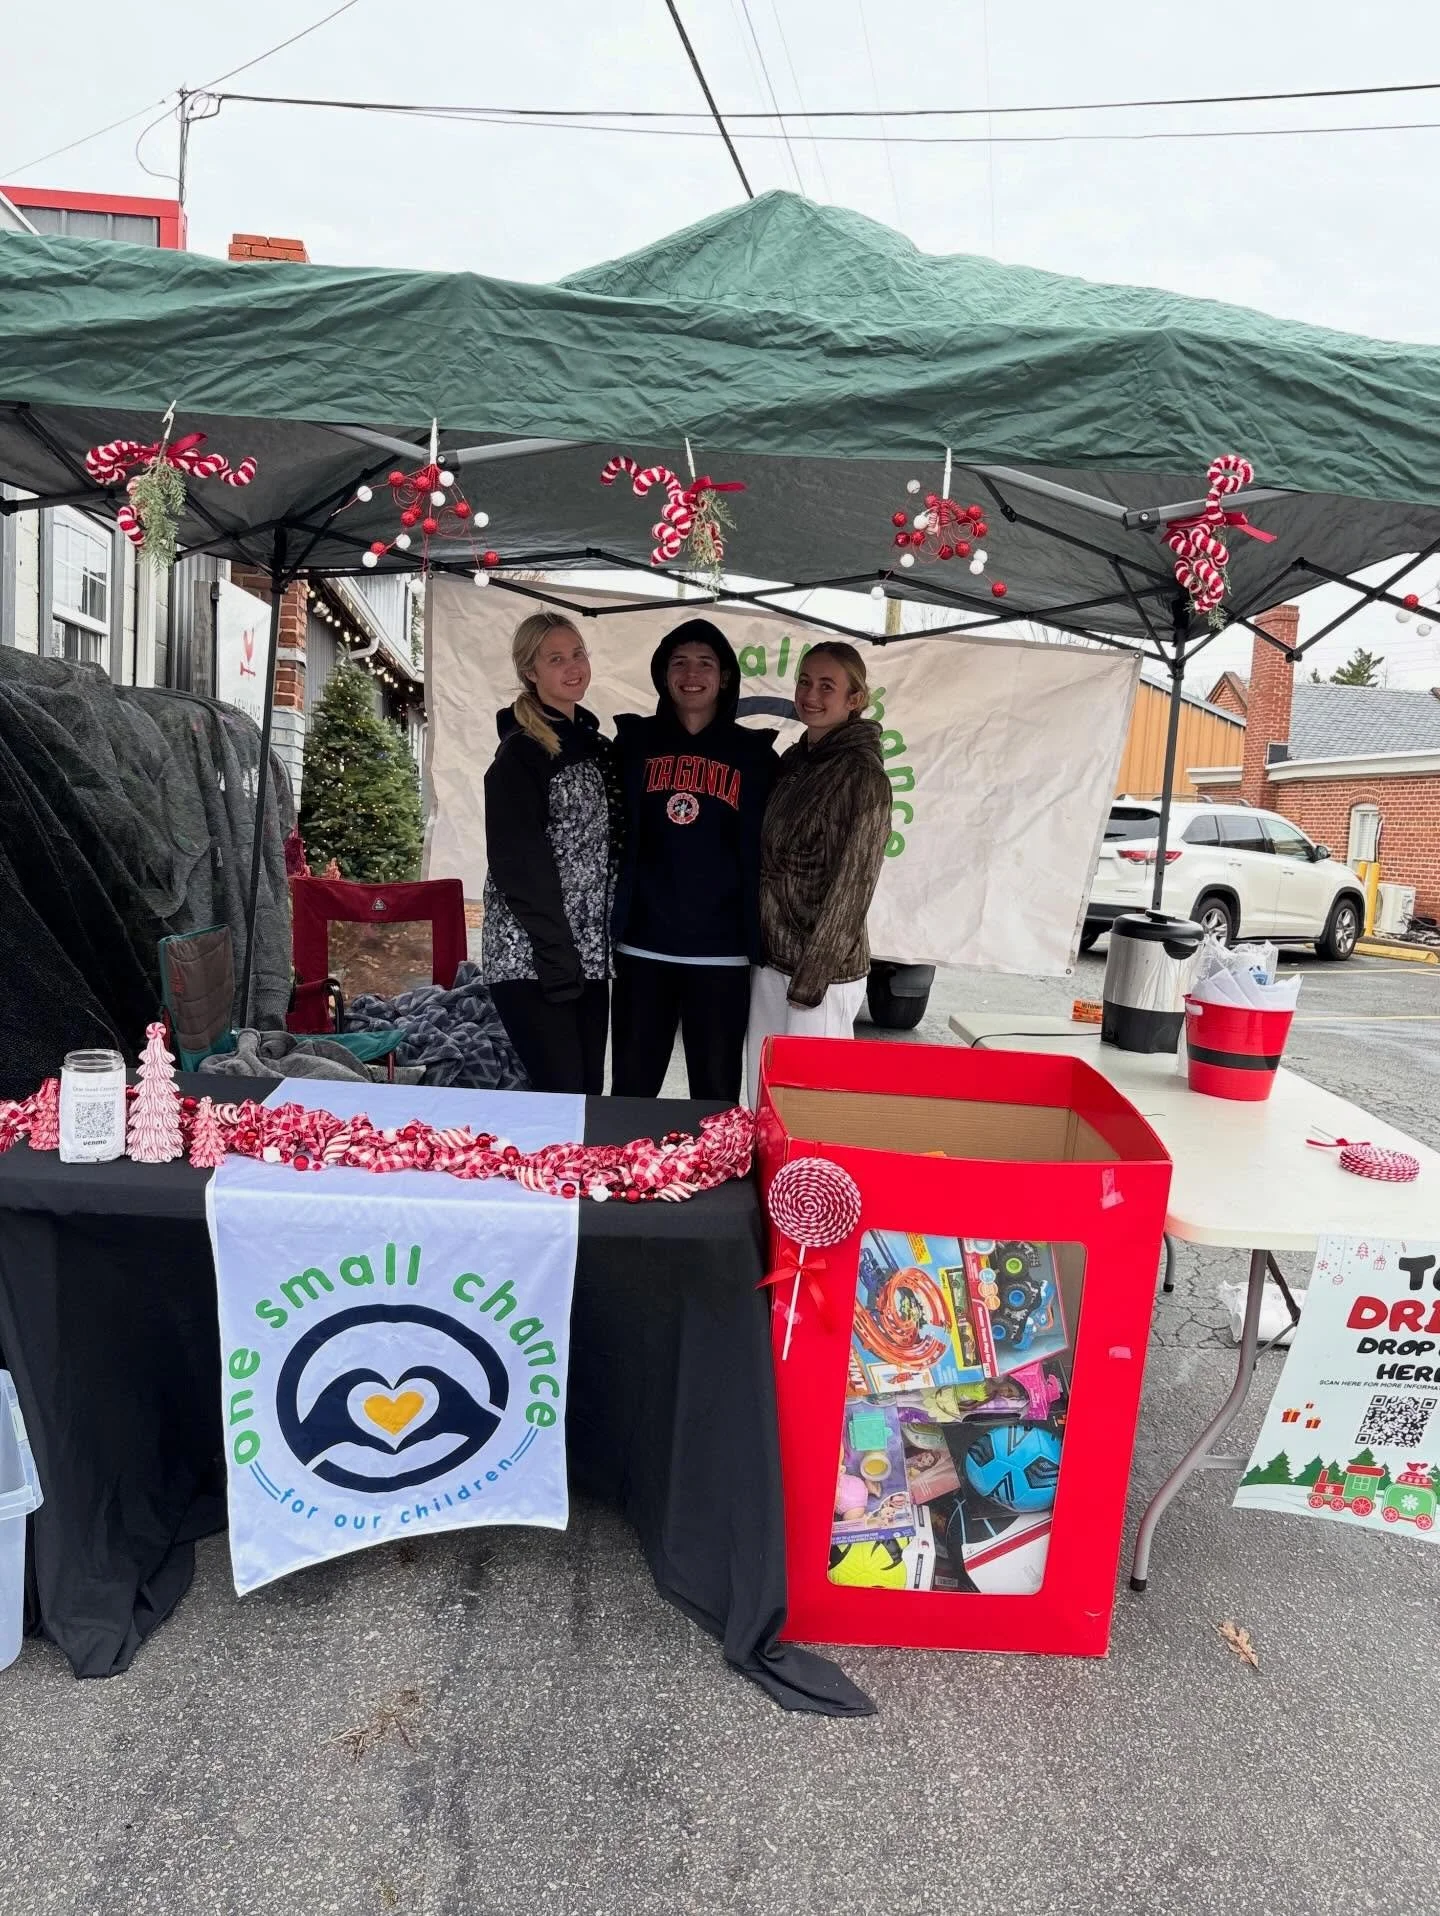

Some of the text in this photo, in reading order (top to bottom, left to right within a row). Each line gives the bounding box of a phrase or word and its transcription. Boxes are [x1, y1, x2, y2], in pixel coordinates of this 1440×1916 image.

[738, 636, 812, 681] all
[643, 755, 742, 811] IRGINIA
[1398, 1254, 1440, 1291] T
[229, 1242, 561, 1465] one small chance
[1356, 1337, 1436, 1356] DROP
[280, 1457, 513, 1529] for our children
